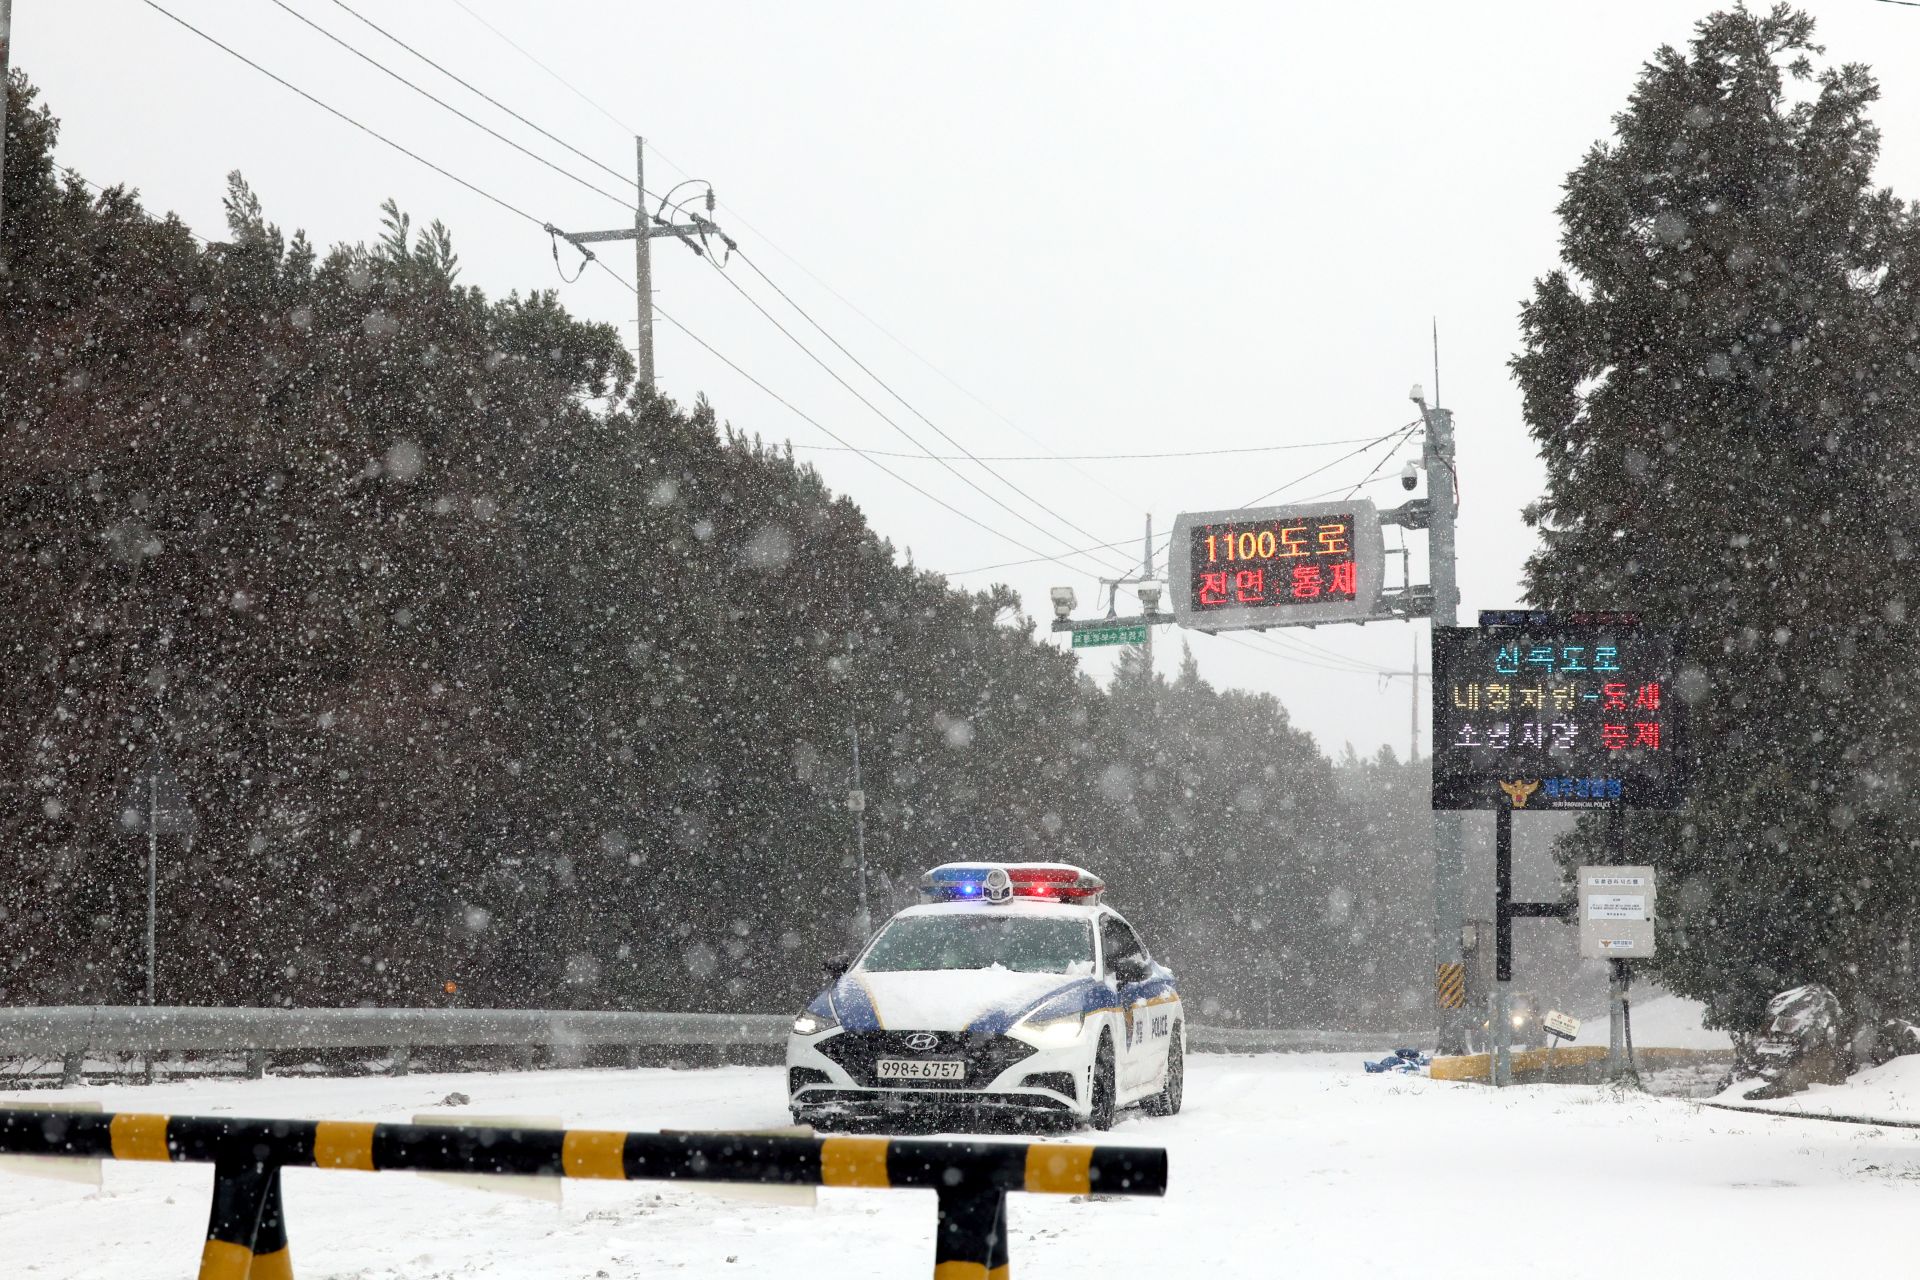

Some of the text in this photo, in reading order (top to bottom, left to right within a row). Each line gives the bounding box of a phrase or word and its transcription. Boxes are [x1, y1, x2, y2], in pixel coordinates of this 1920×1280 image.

[1205, 524, 1348, 562] 1100도로
[1291, 561, 1358, 598] 통제
[1151, 1014, 1168, 1039] POLICE
[882, 1062, 960, 1077] 998수 6757
